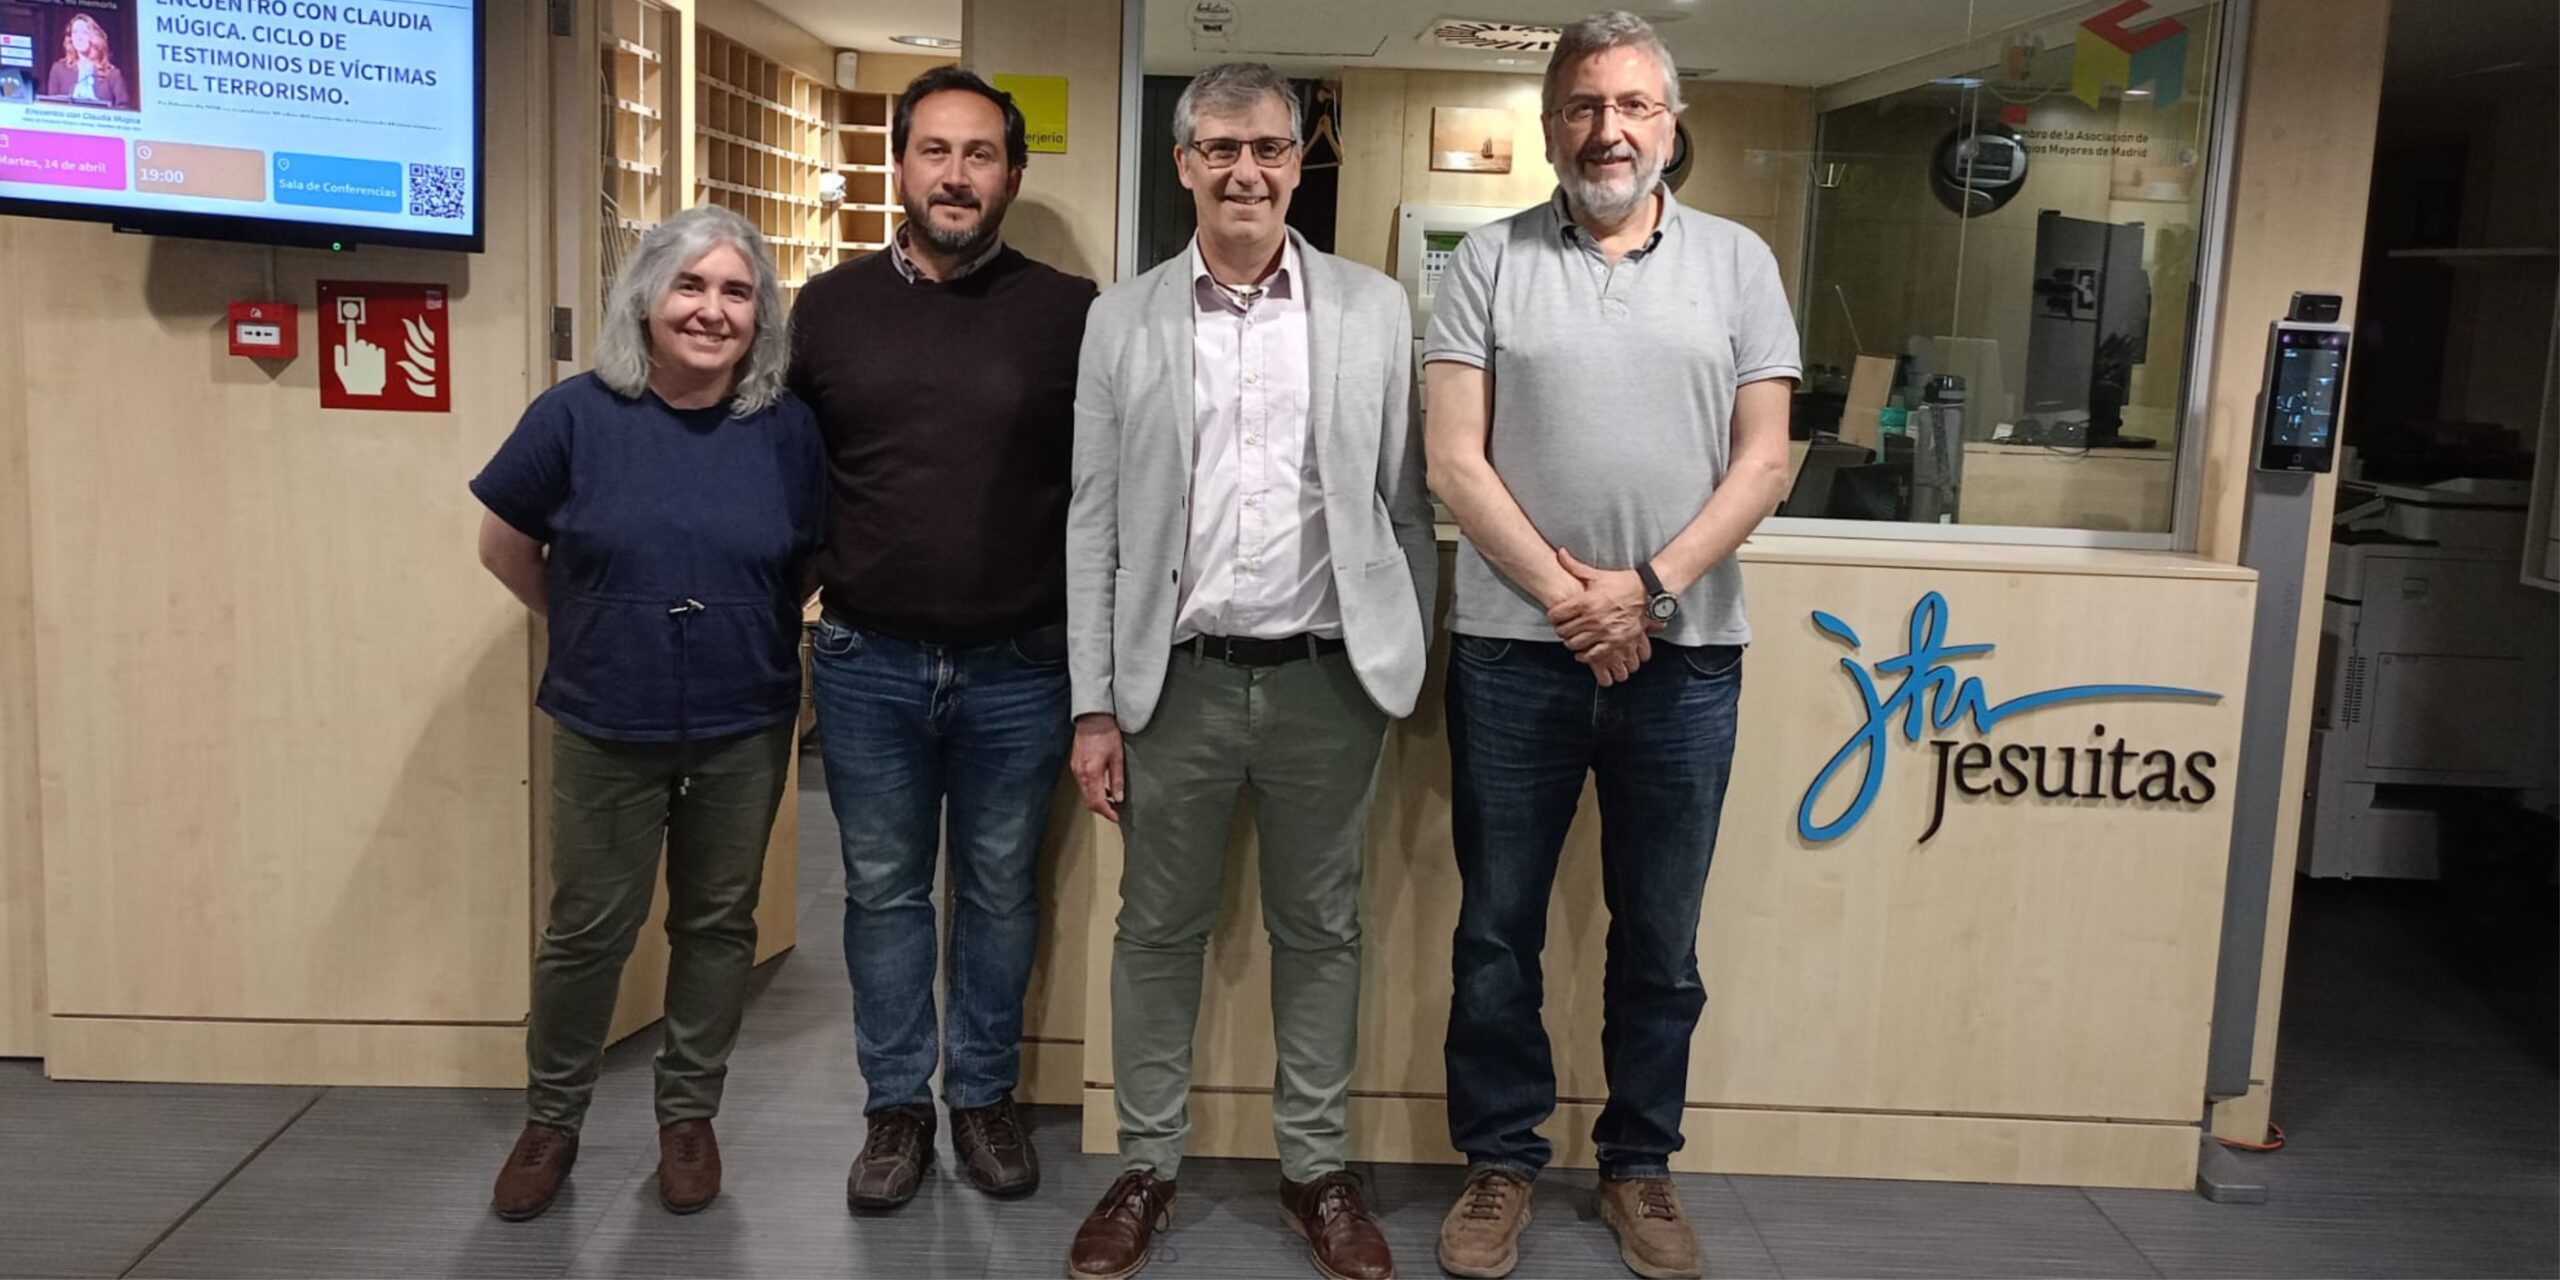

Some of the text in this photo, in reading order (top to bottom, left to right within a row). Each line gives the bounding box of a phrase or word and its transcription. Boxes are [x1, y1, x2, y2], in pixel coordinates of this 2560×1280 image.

[156, 0, 433, 32] UENTRO CON CLAUDIA
[157, 14, 347, 51] MÚGICA. CICLO DE
[156, 44, 438, 87] TESTIMONIOS DE VÍCTIMAS
[158, 71, 349, 106] DEL TERRORISMO.
[1025, 131, 1063, 145] erjería
[2021, 129, 2047, 139] mbro
[2049, 130, 2062, 139] de
[2135, 132, 2149, 143] de
[2049, 144, 2094, 157] Mayores
[2096, 147, 2109, 156] de
[2111, 147, 2148, 158] Madrid
[44, 158, 59, 169] 14
[61, 160, 77, 171] de
[79, 162, 107, 174] abril
[140, 168, 184, 184] 19:00
[279, 178, 397, 199] Sala de Conferencias
